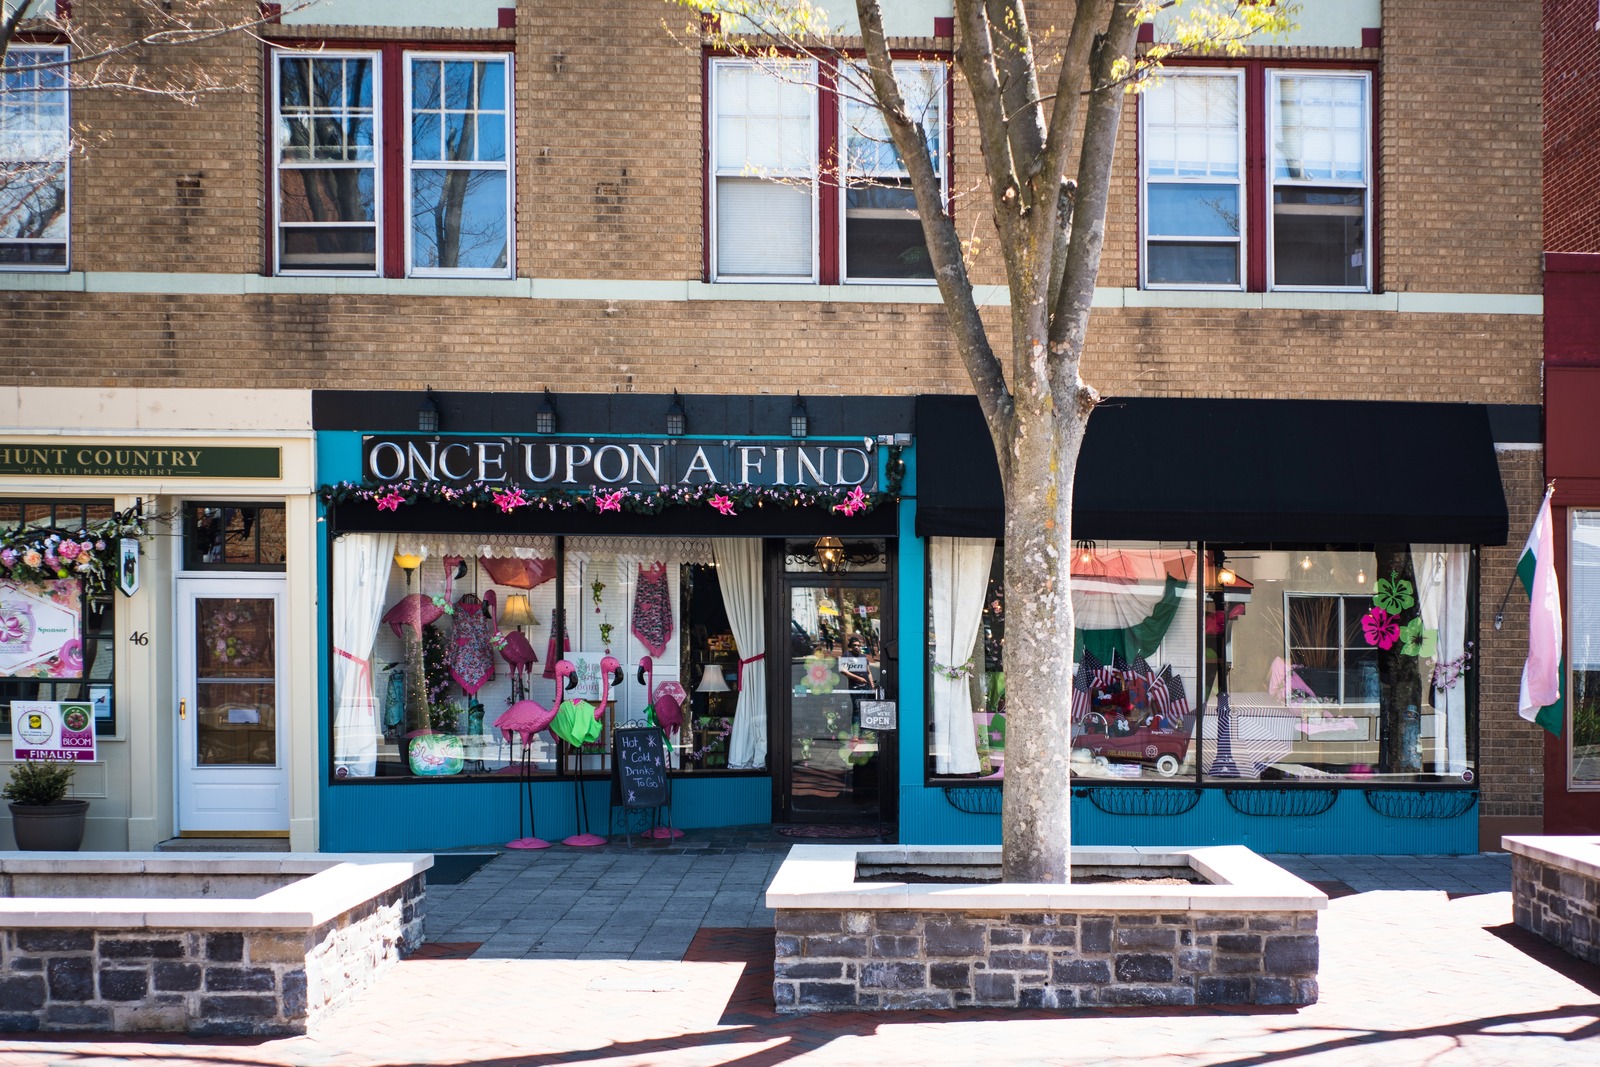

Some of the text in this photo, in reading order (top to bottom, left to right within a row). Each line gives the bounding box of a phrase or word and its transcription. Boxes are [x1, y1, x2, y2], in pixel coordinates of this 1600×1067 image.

[0, 448, 202, 467] HUNT COUNTRY
[369, 441, 870, 486] ONCE UPON A FIND
[23, 467, 77, 475] WEALTH
[129, 631, 149, 646] 46
[865, 716, 890, 725] OPEN
[29, 750, 80, 760] FINALIST
[631, 752, 651, 763] Cold
[625, 766, 655, 777] Drinks
[633, 777, 645, 787] To
